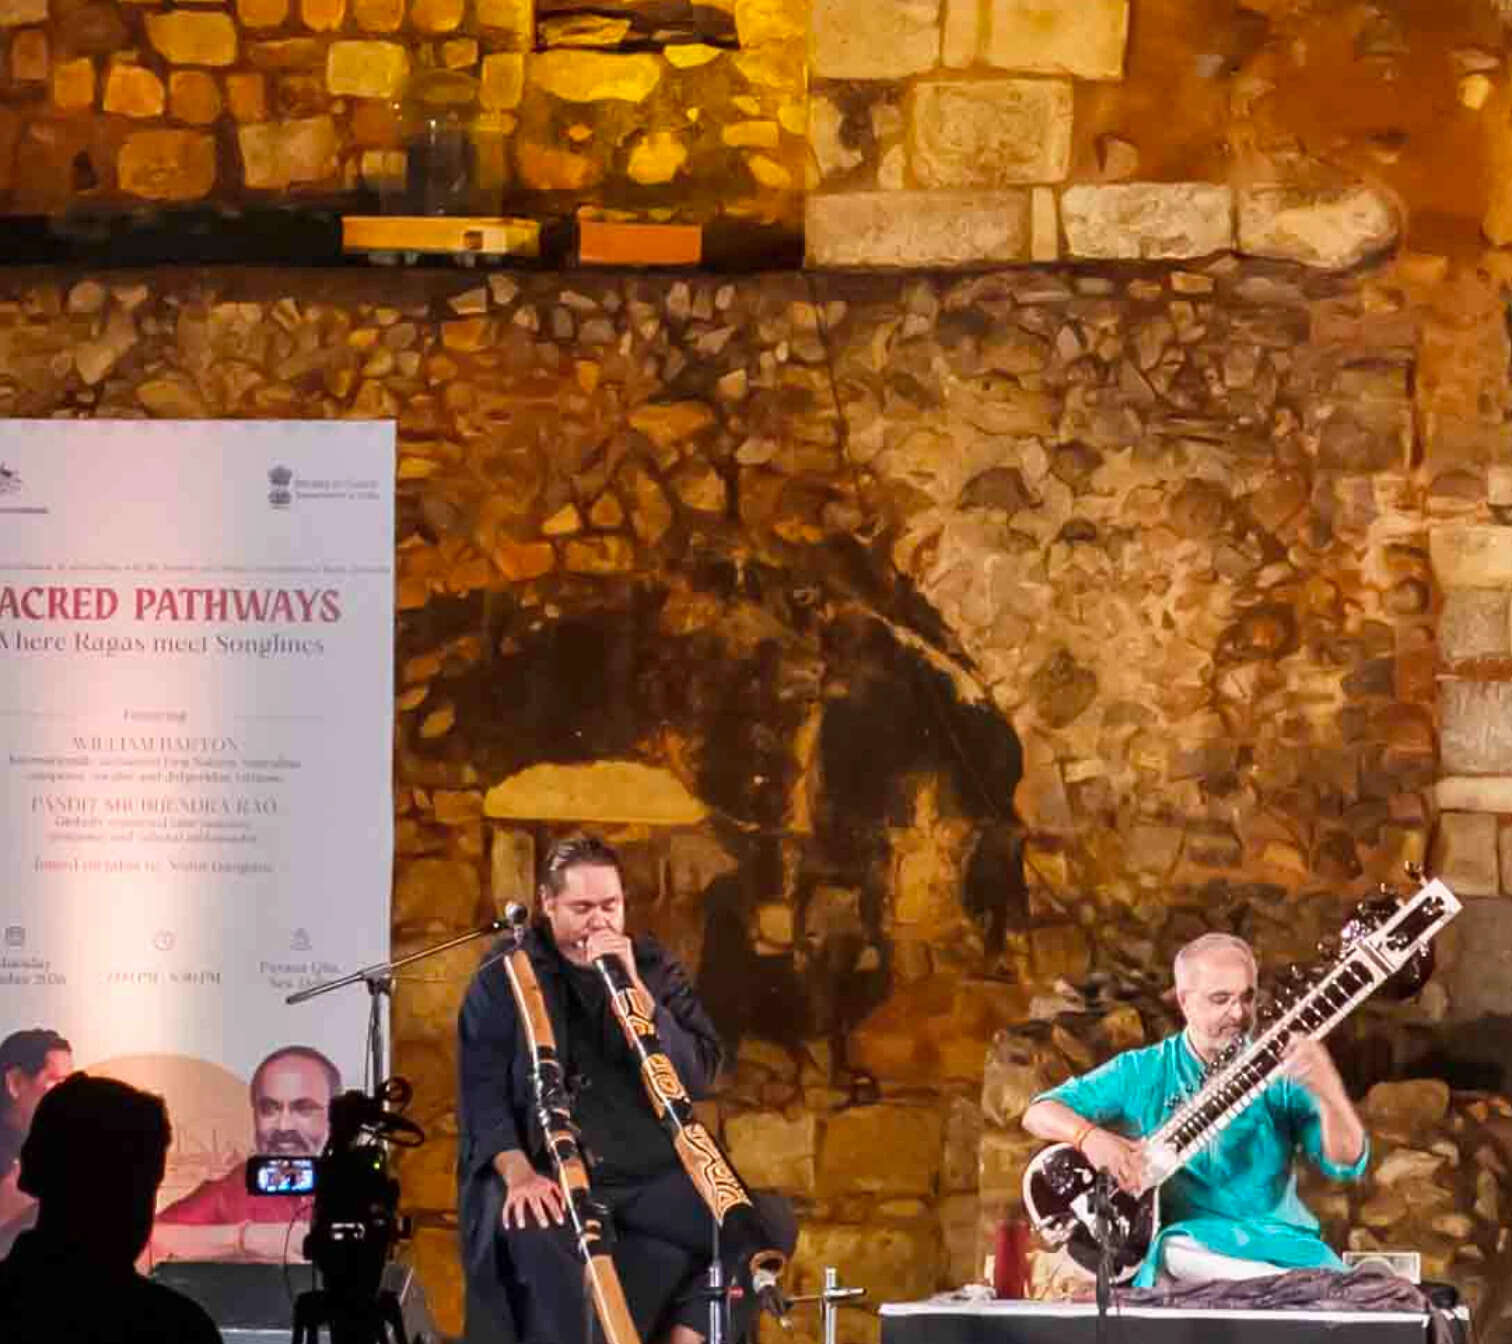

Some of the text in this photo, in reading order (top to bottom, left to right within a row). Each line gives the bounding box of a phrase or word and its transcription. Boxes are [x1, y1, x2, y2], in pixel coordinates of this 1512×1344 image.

[133, 587, 342, 623] PATHWAYS
[74, 632, 145, 657] Ragas
[153, 633, 208, 654] meet
[215, 633, 325, 659] Songlines
